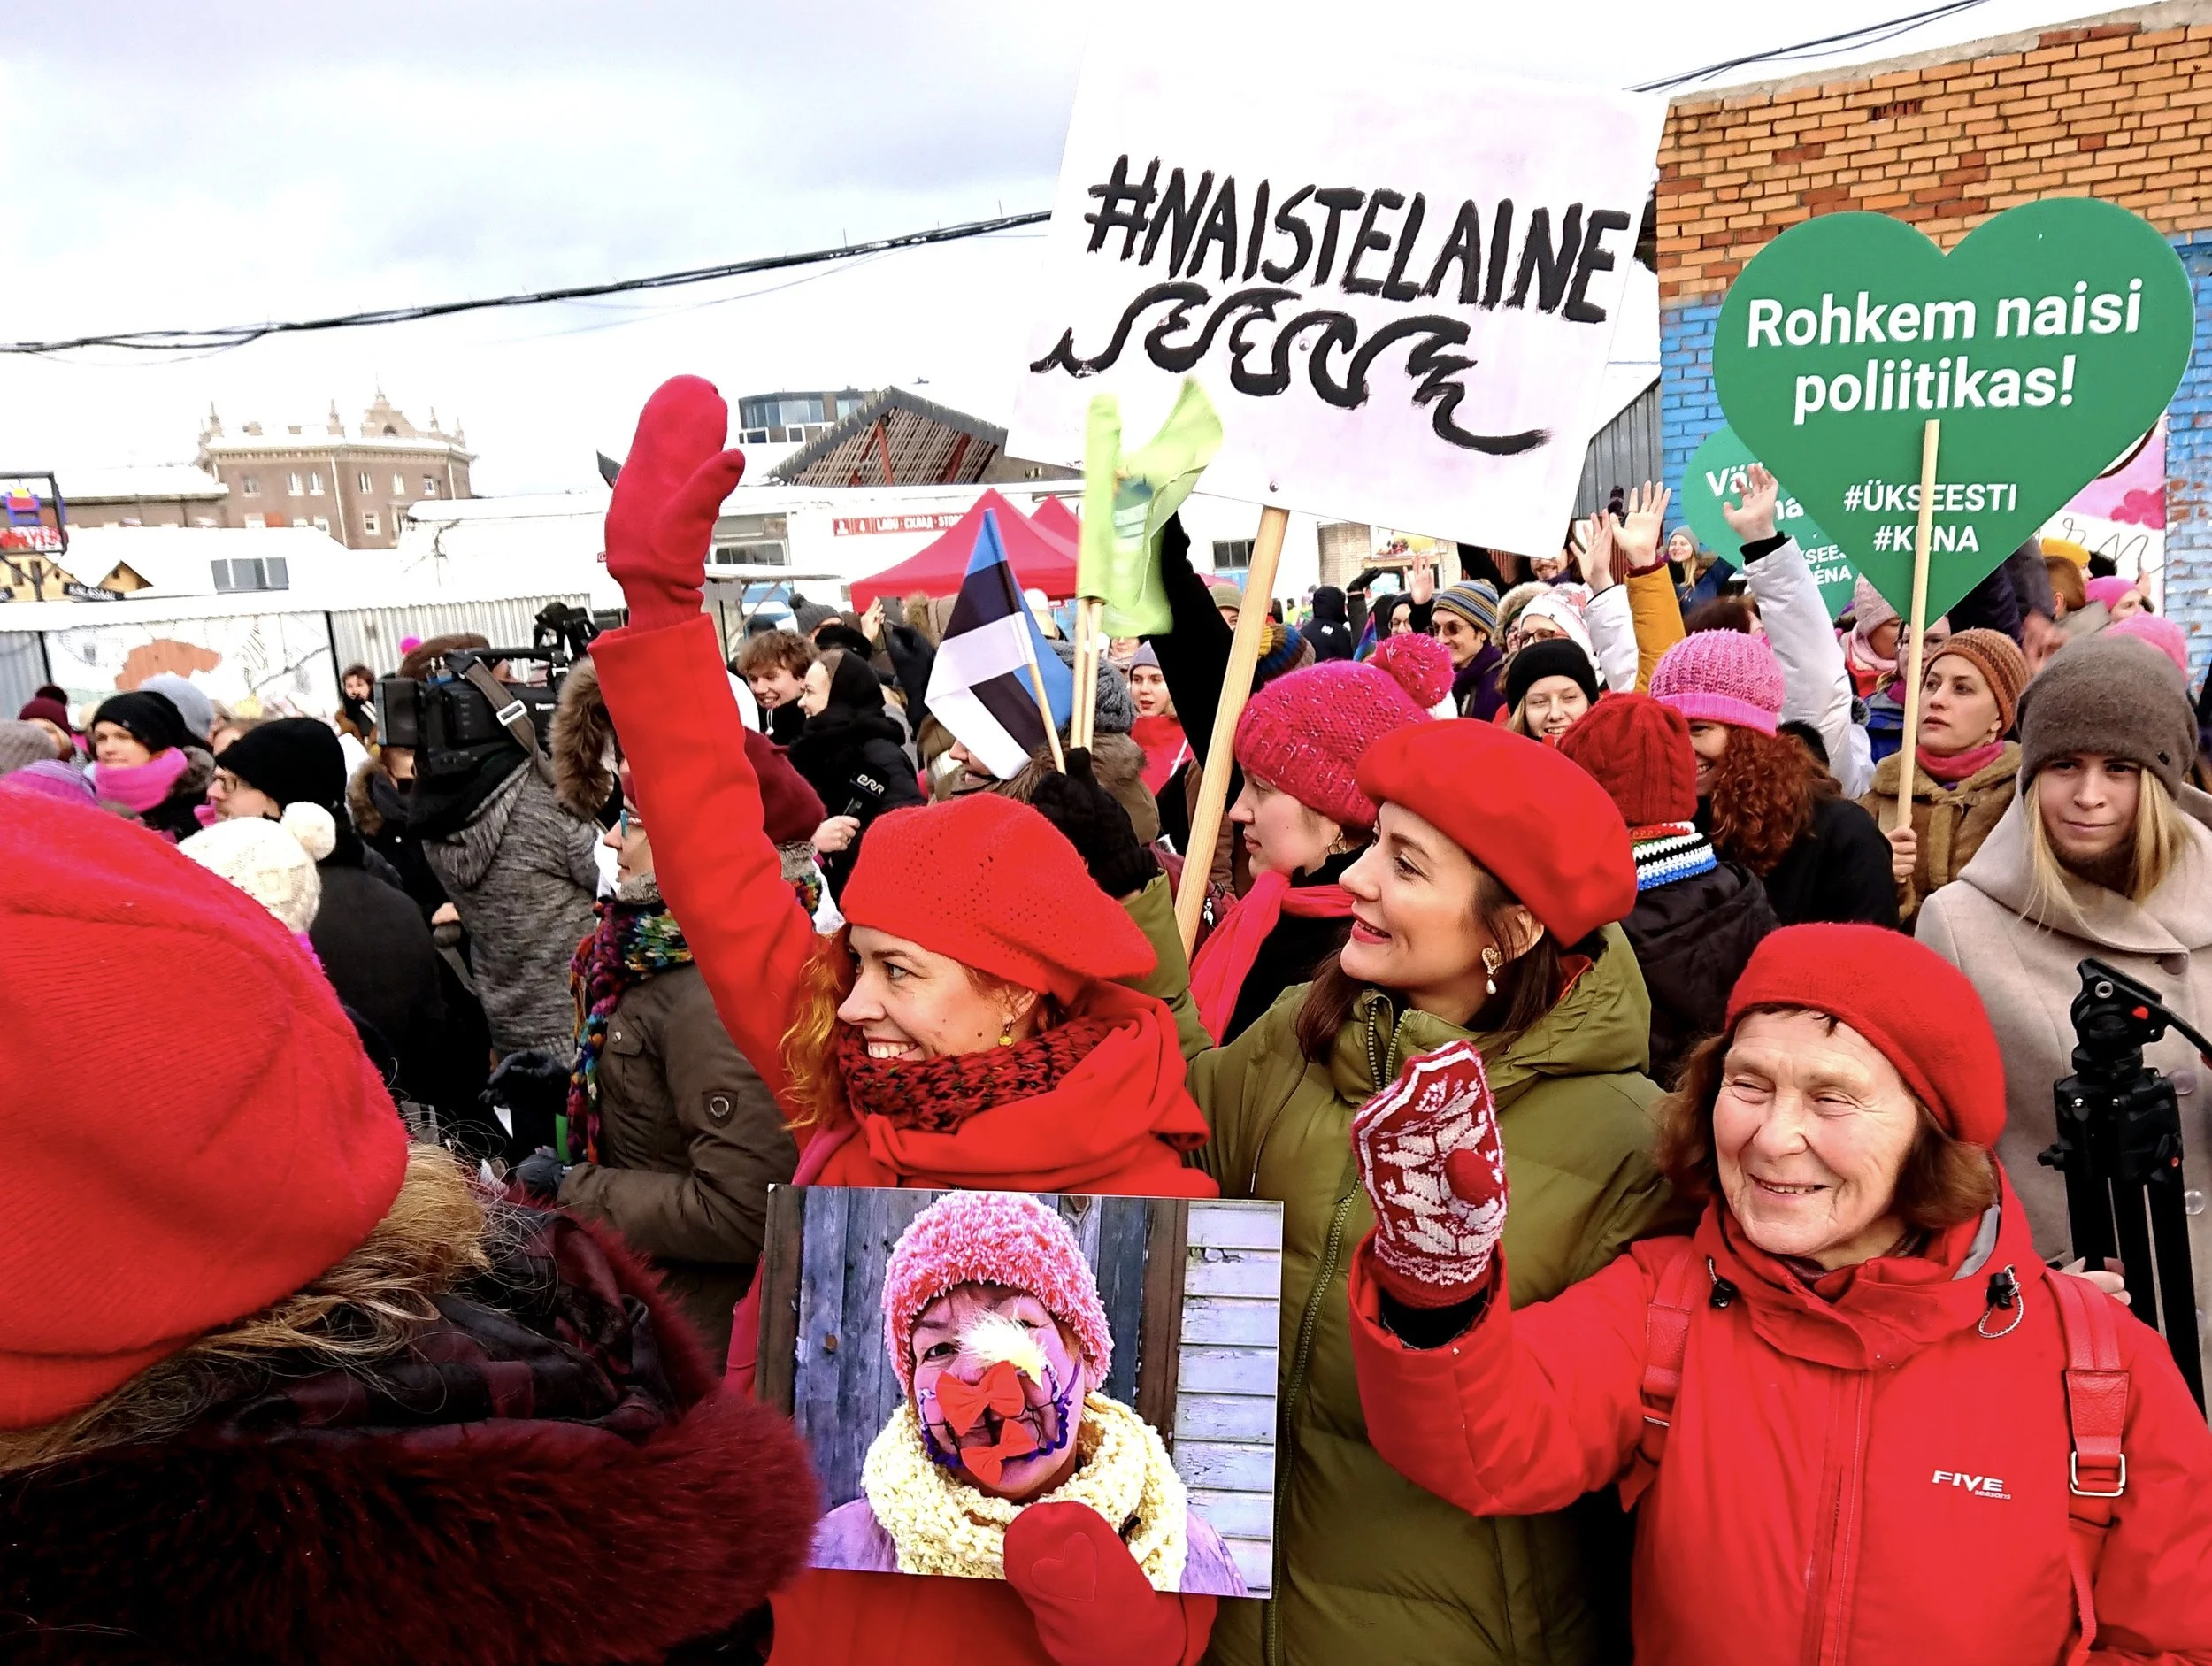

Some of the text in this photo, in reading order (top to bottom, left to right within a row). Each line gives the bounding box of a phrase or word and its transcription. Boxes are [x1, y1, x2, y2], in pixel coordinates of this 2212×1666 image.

[1085, 153, 1632, 324] #NAISTELAINE
[1746, 278, 2145, 348] Rohkem naisi
[1793, 354, 2078, 426] poliitikas!
[1705, 463, 1763, 497] Vä
[1843, 479, 2017, 511] #ÜKSEESTI
[1801, 544, 1847, 565] SEE
[1873, 526, 1980, 552] #KNA
[1813, 564, 1853, 586] ENA
[1932, 1470, 2004, 1492] FIVE
